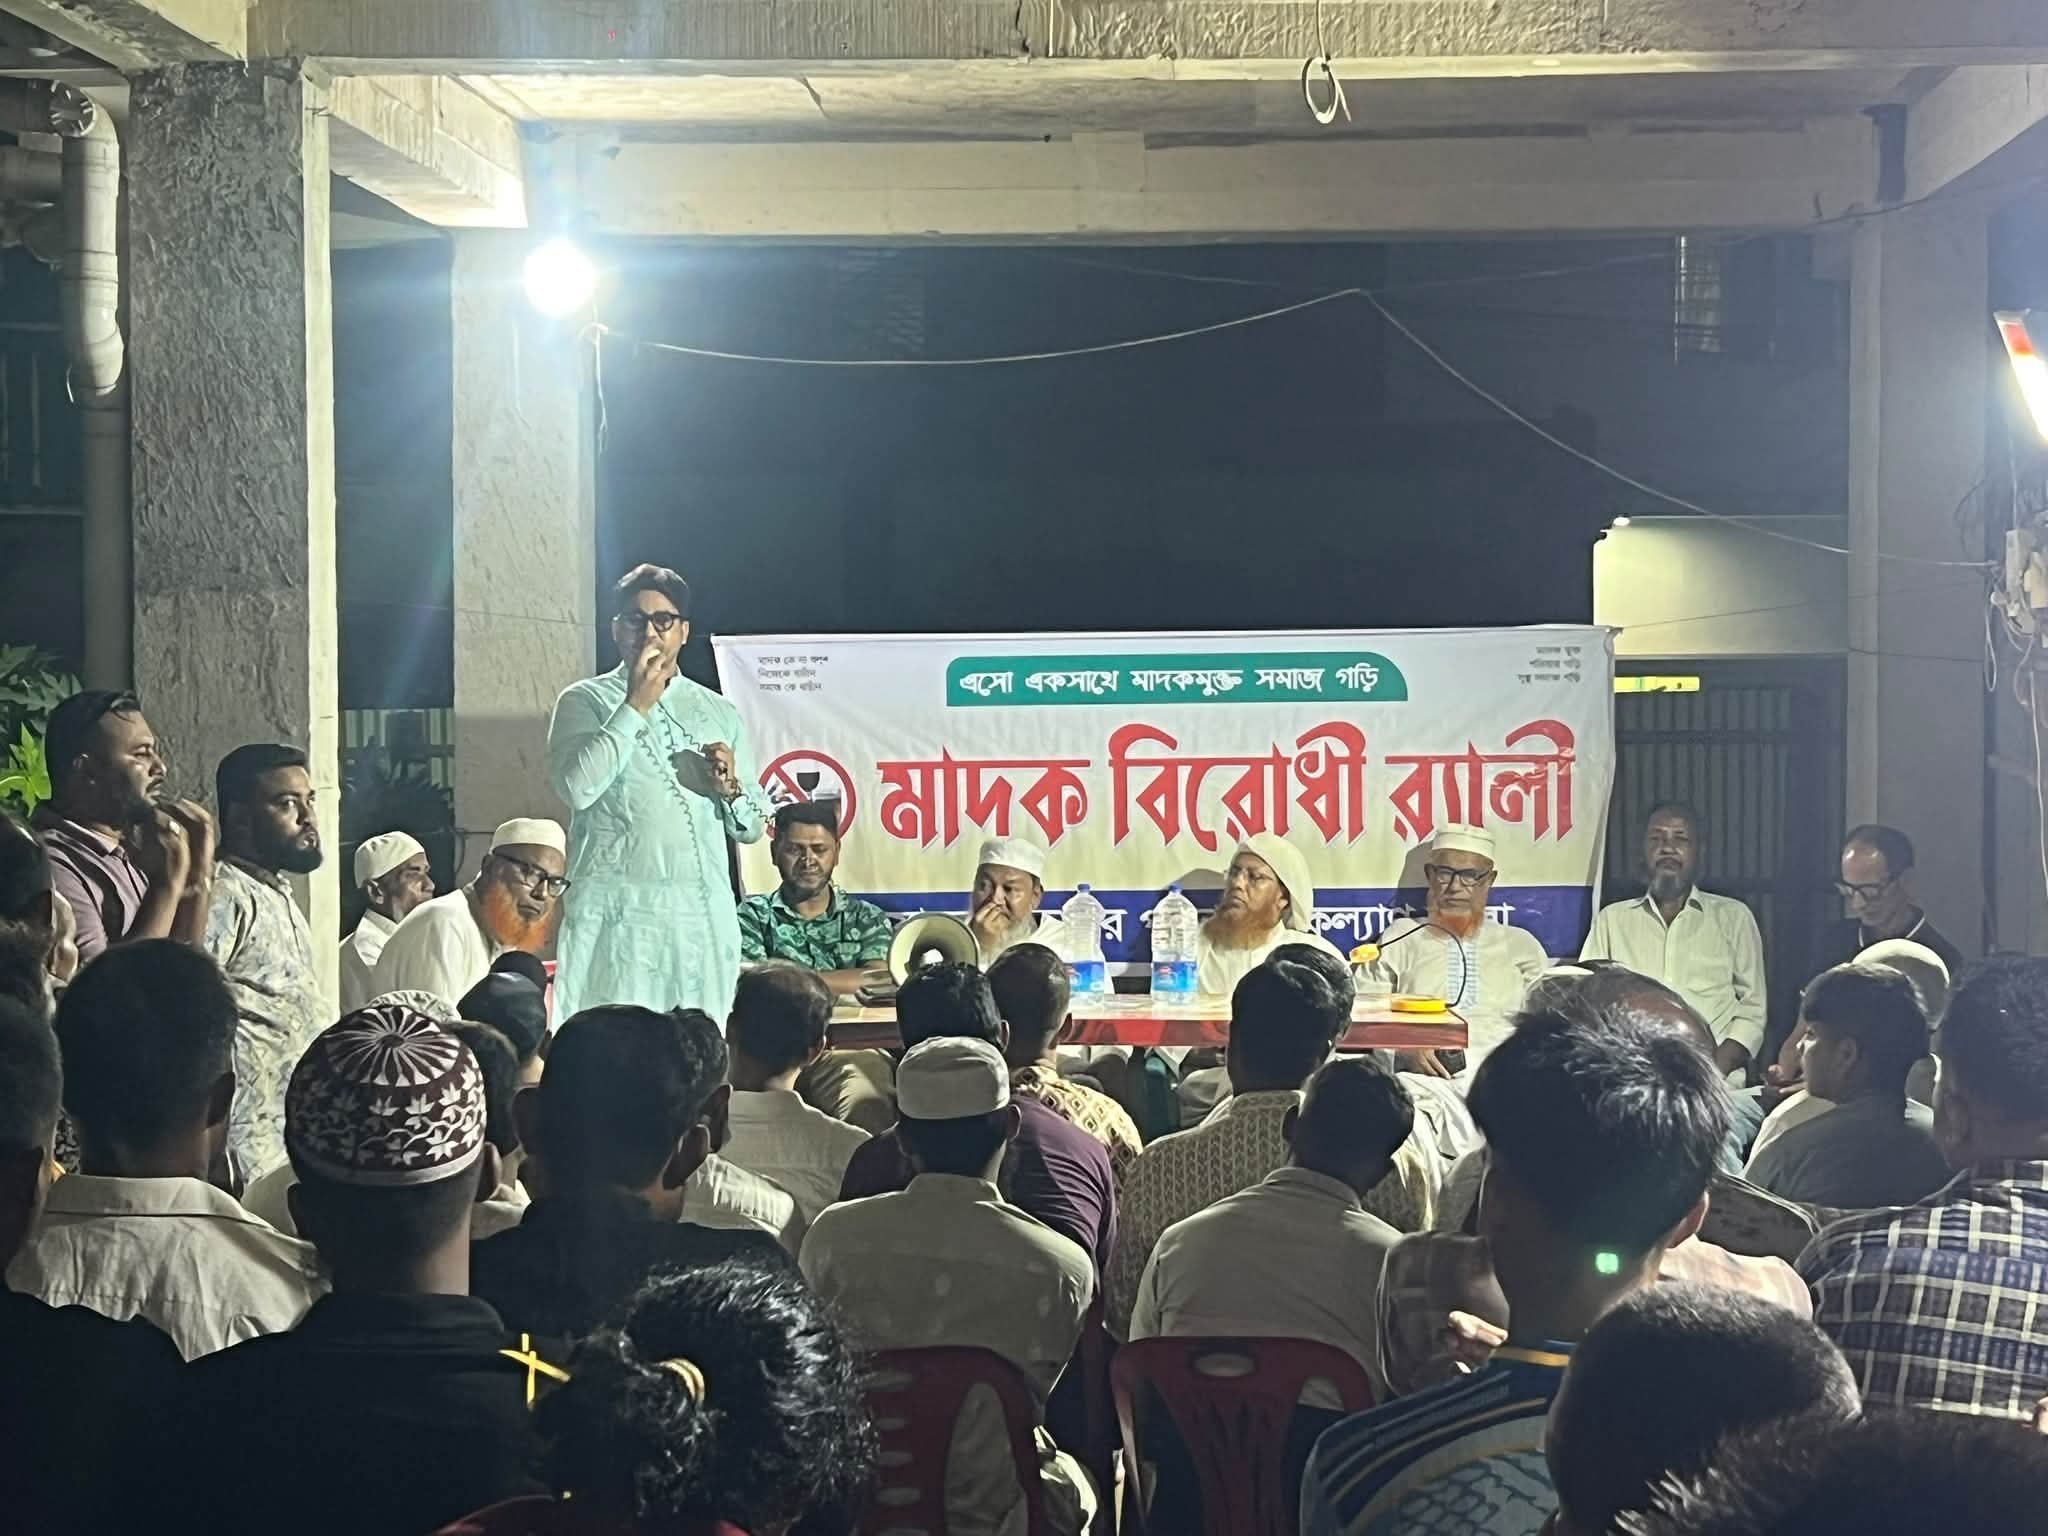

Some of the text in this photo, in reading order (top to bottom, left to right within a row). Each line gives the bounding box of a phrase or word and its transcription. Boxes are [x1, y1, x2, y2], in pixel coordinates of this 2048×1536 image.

[959, 662, 1380, 698] এসো একসাথে মাদকমুক্ত সমাজ গড়ি
[877, 747, 1090, 847] মাদক
[1108, 722, 1367, 851] বিরোধী
